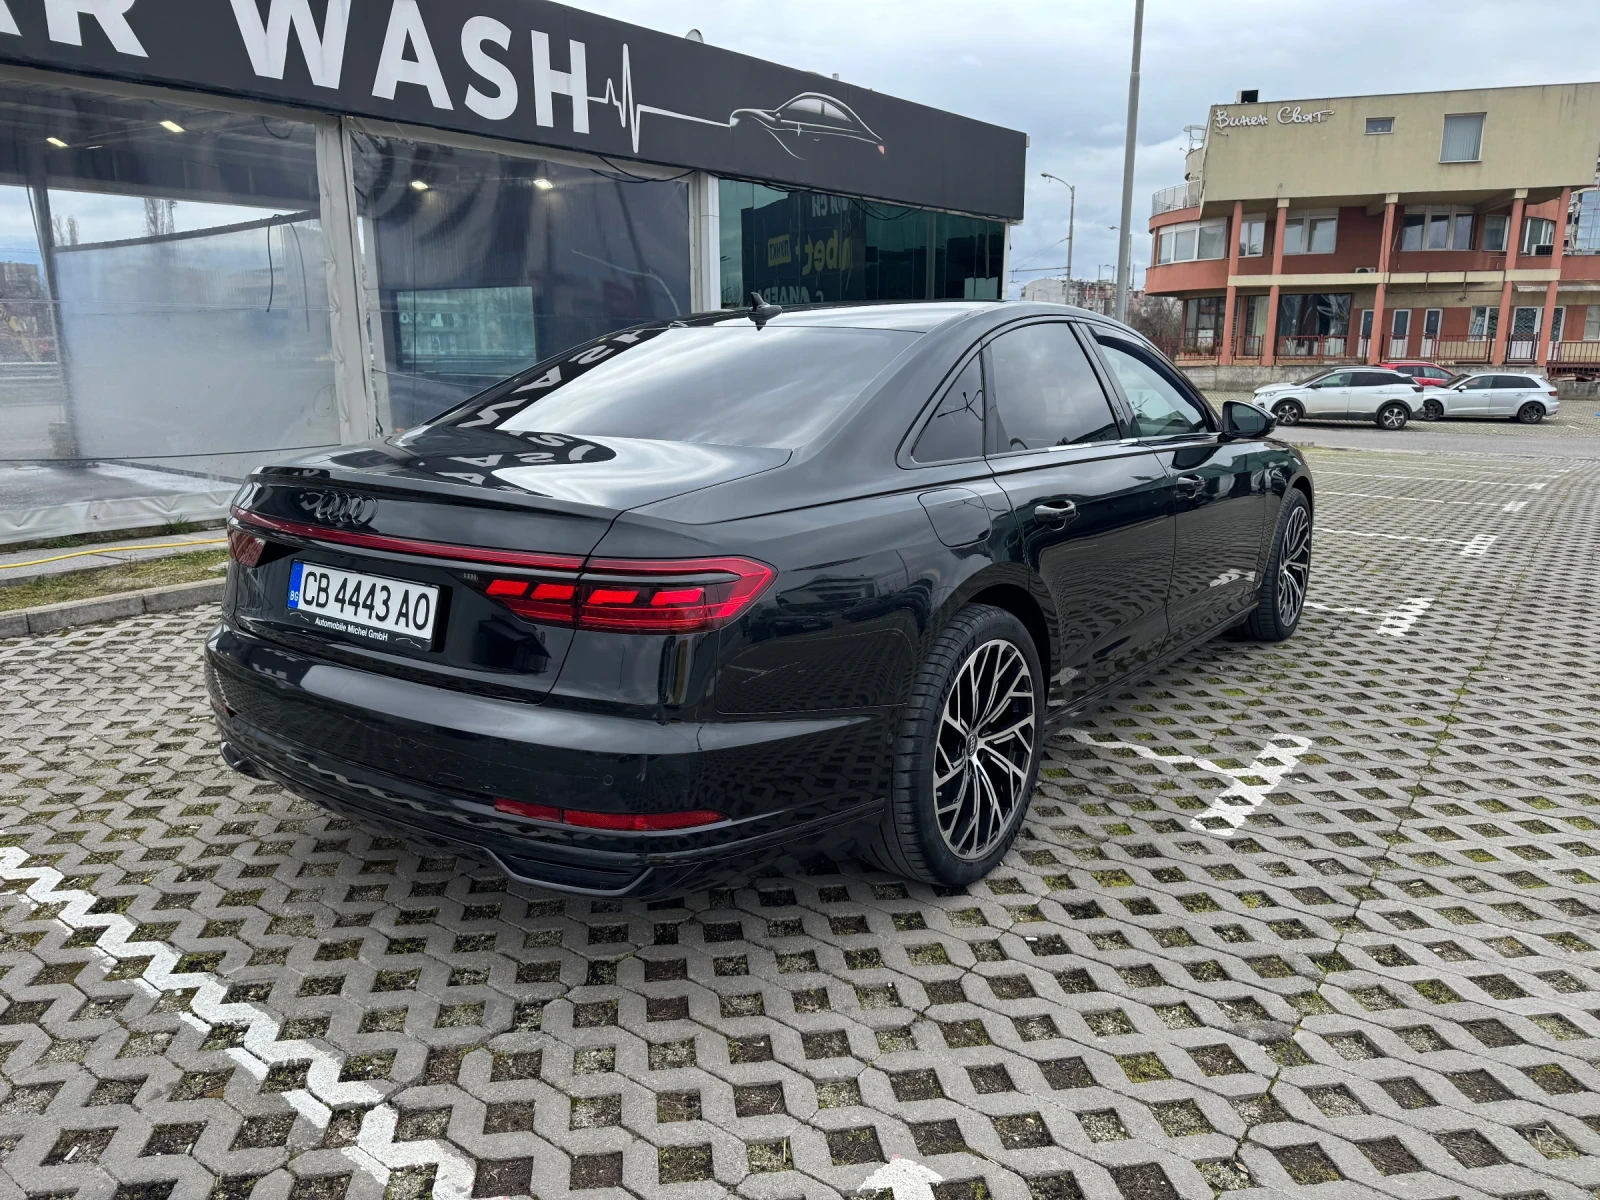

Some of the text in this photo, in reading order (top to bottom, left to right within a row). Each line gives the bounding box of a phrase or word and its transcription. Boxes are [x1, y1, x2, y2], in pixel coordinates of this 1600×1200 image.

[229, 0, 590, 134] WASH
[1277, 106, 1335, 124] Свят
[290, 590, 299, 602] BG
[302, 571, 331, 609] CB
[334, 577, 392, 623] 4443
[314, 616, 389, 642] Automobile Michel GmbH
